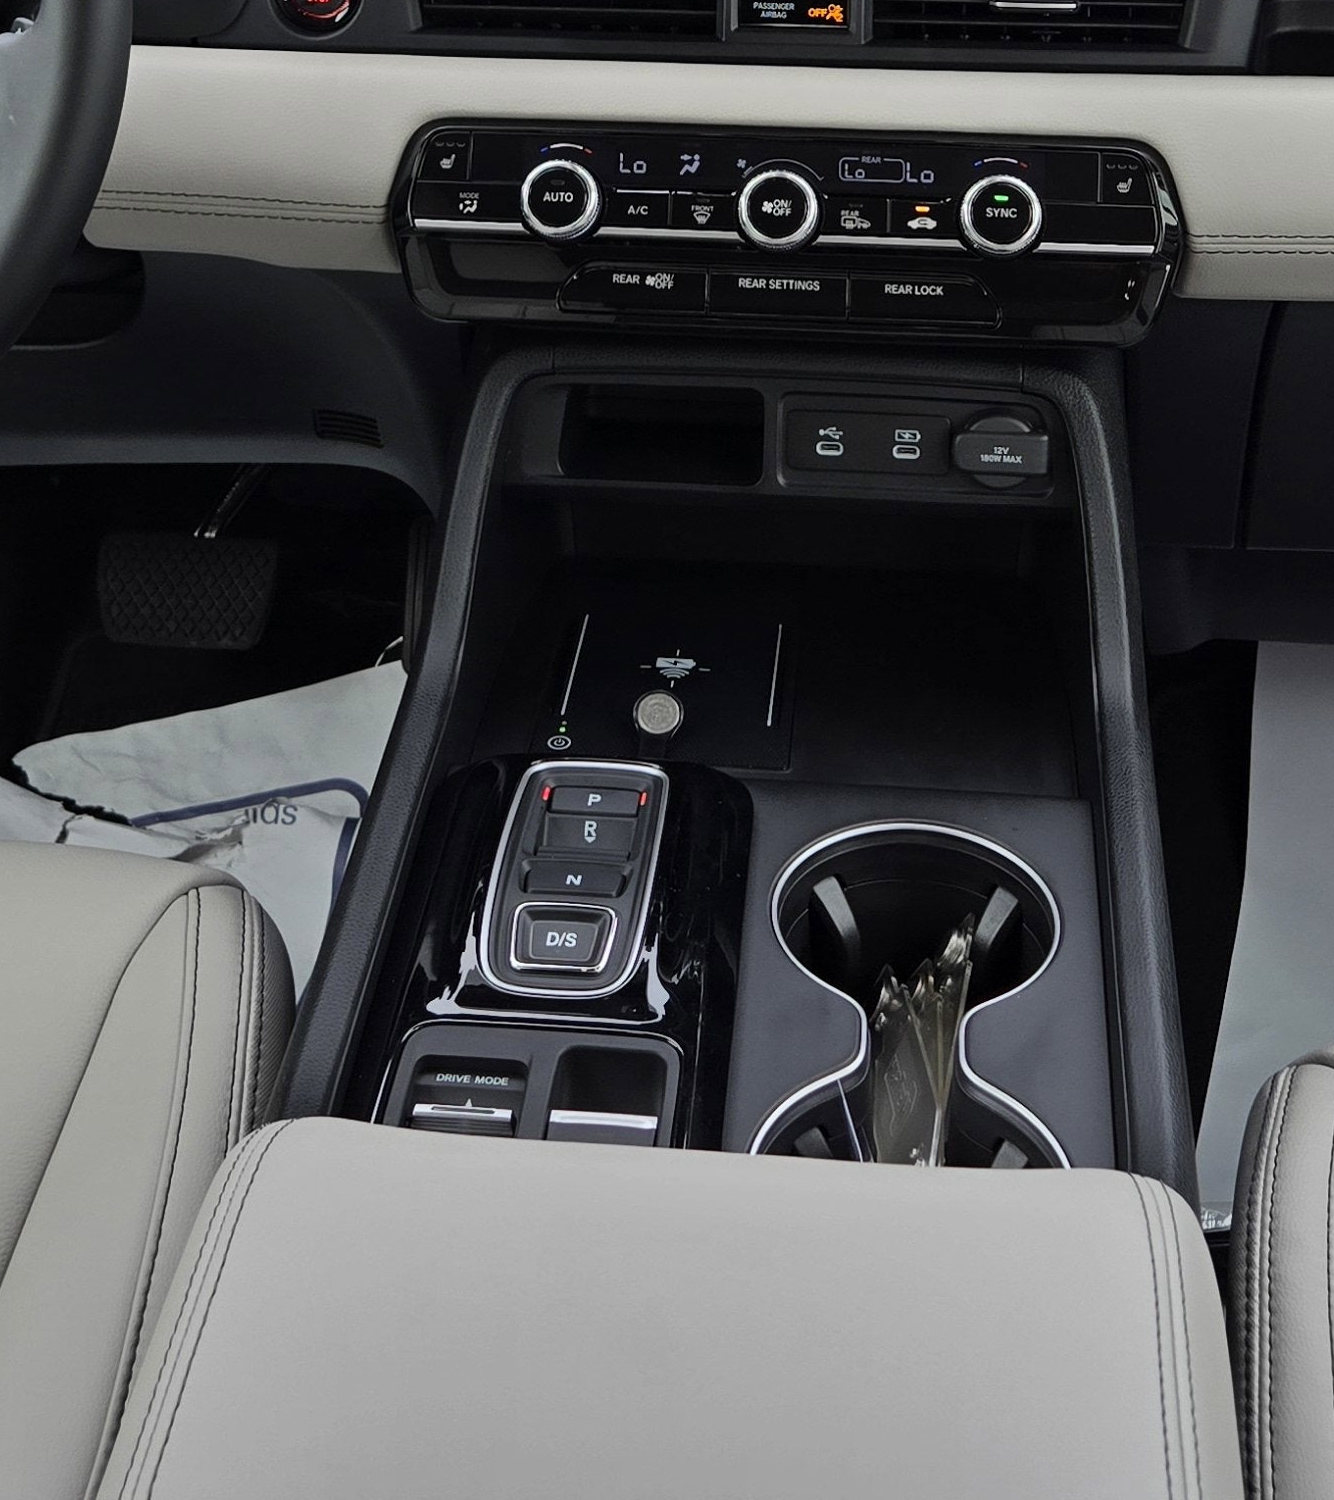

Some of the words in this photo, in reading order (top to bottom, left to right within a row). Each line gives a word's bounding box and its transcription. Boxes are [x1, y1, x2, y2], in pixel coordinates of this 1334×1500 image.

[753, 2, 796, 11] PASSENGER
[760, 10, 788, 20] AIRBAG
[807, 7, 828, 19] OFF
[861, 156, 882, 164] REAR
[459, 192, 480, 200] MODE
[543, 191, 574, 203] AUTO
[691, 205, 715, 213] FRONT
[773, 199, 792, 209] ON/
[627, 205, 649, 217] A/C
[773, 207, 792, 217] OFF
[985, 206, 1017, 219] SYNC
[612, 273, 640, 286] REAR
[655, 273, 675, 283] ON/
[655, 280, 674, 290] OFF
[738, 277, 767, 289] REAR
[769, 278, 820, 292] SETTINGS
[884, 283, 912, 295] REAR
[915, 284, 944, 296] LOCK
[993, 446, 1009, 456] 12V
[1003, 454, 1022, 464] MAX
[586, 793, 602, 807] P
[584, 821, 597, 838] R
[565, 875, 583, 886] N
[546, 930, 578, 949] D/S
[436, 1073, 472, 1085] DRIVE
[474, 1074, 509, 1086] MODE
